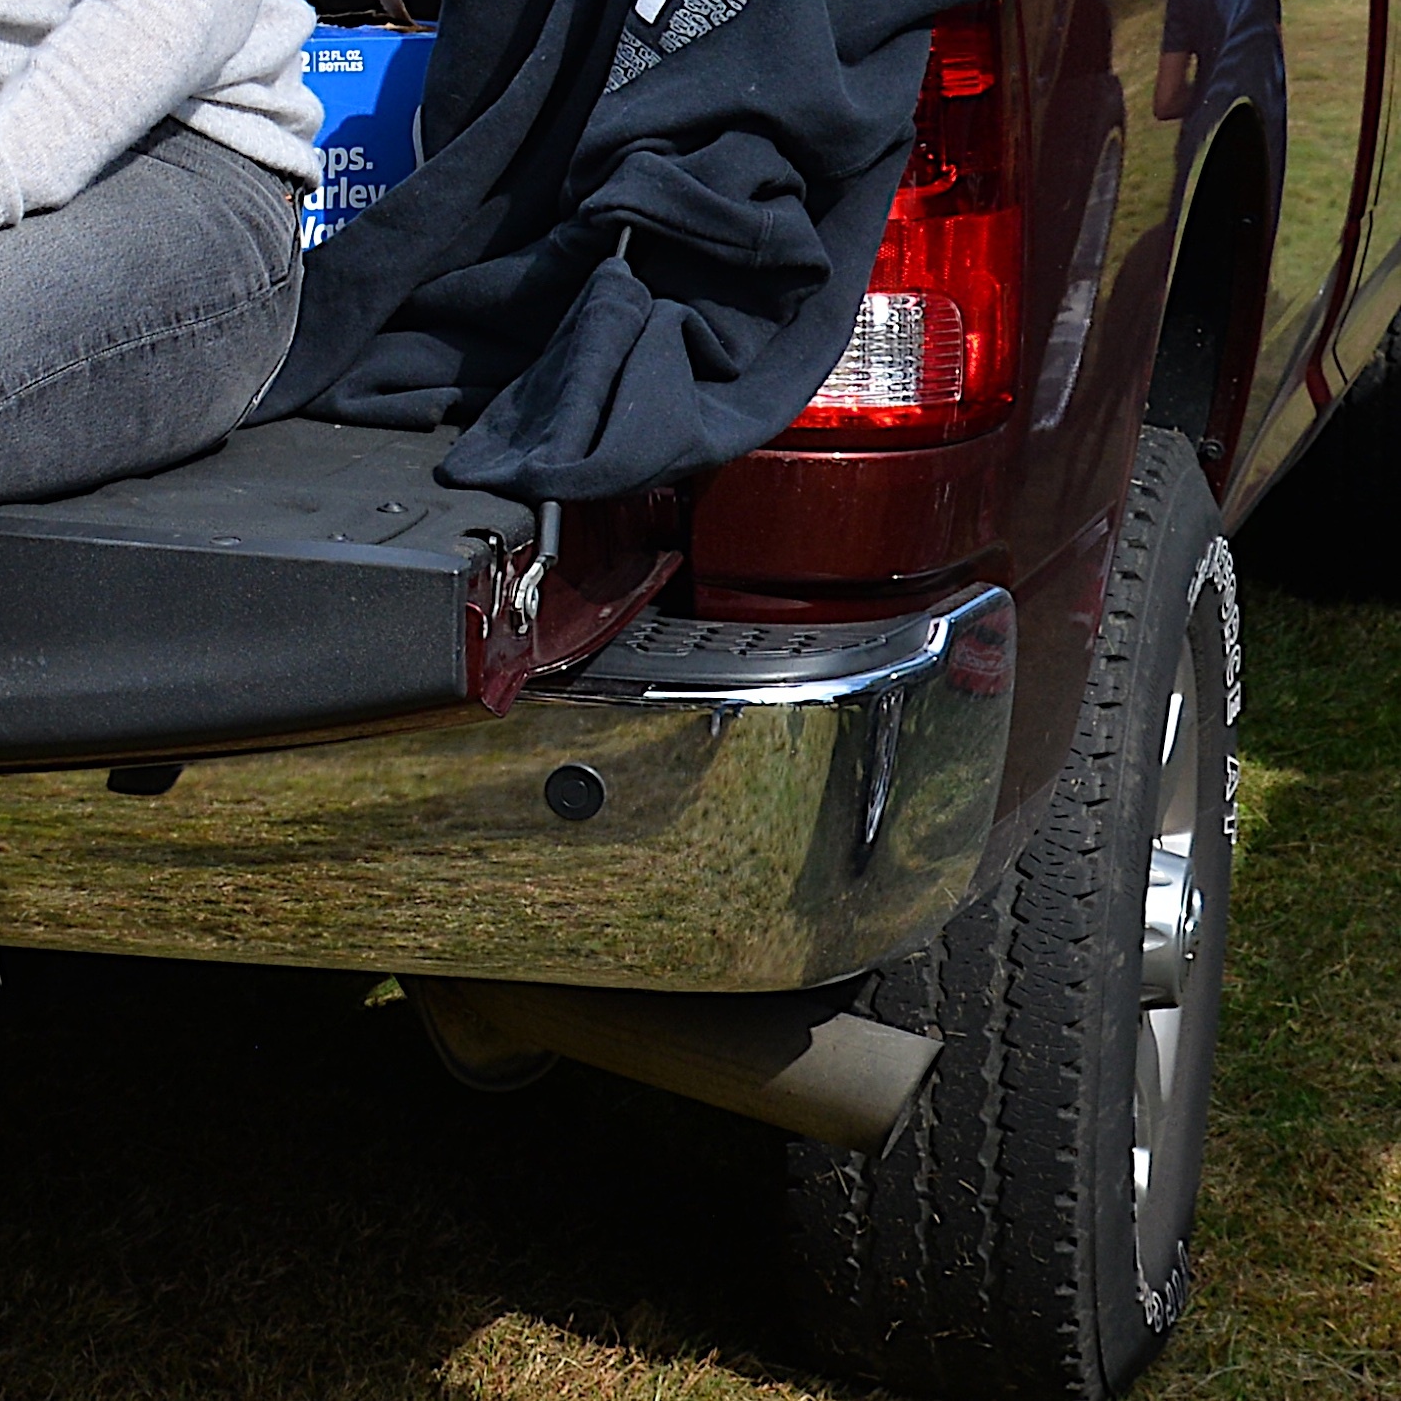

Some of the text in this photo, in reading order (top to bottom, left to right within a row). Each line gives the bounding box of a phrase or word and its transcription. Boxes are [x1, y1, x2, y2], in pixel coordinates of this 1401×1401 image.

[318, 50, 332, 62] 12
[318, 61, 364, 73] BOTTLES
[314, 146, 374, 179] ops.
[304, 177, 387, 210] arley
